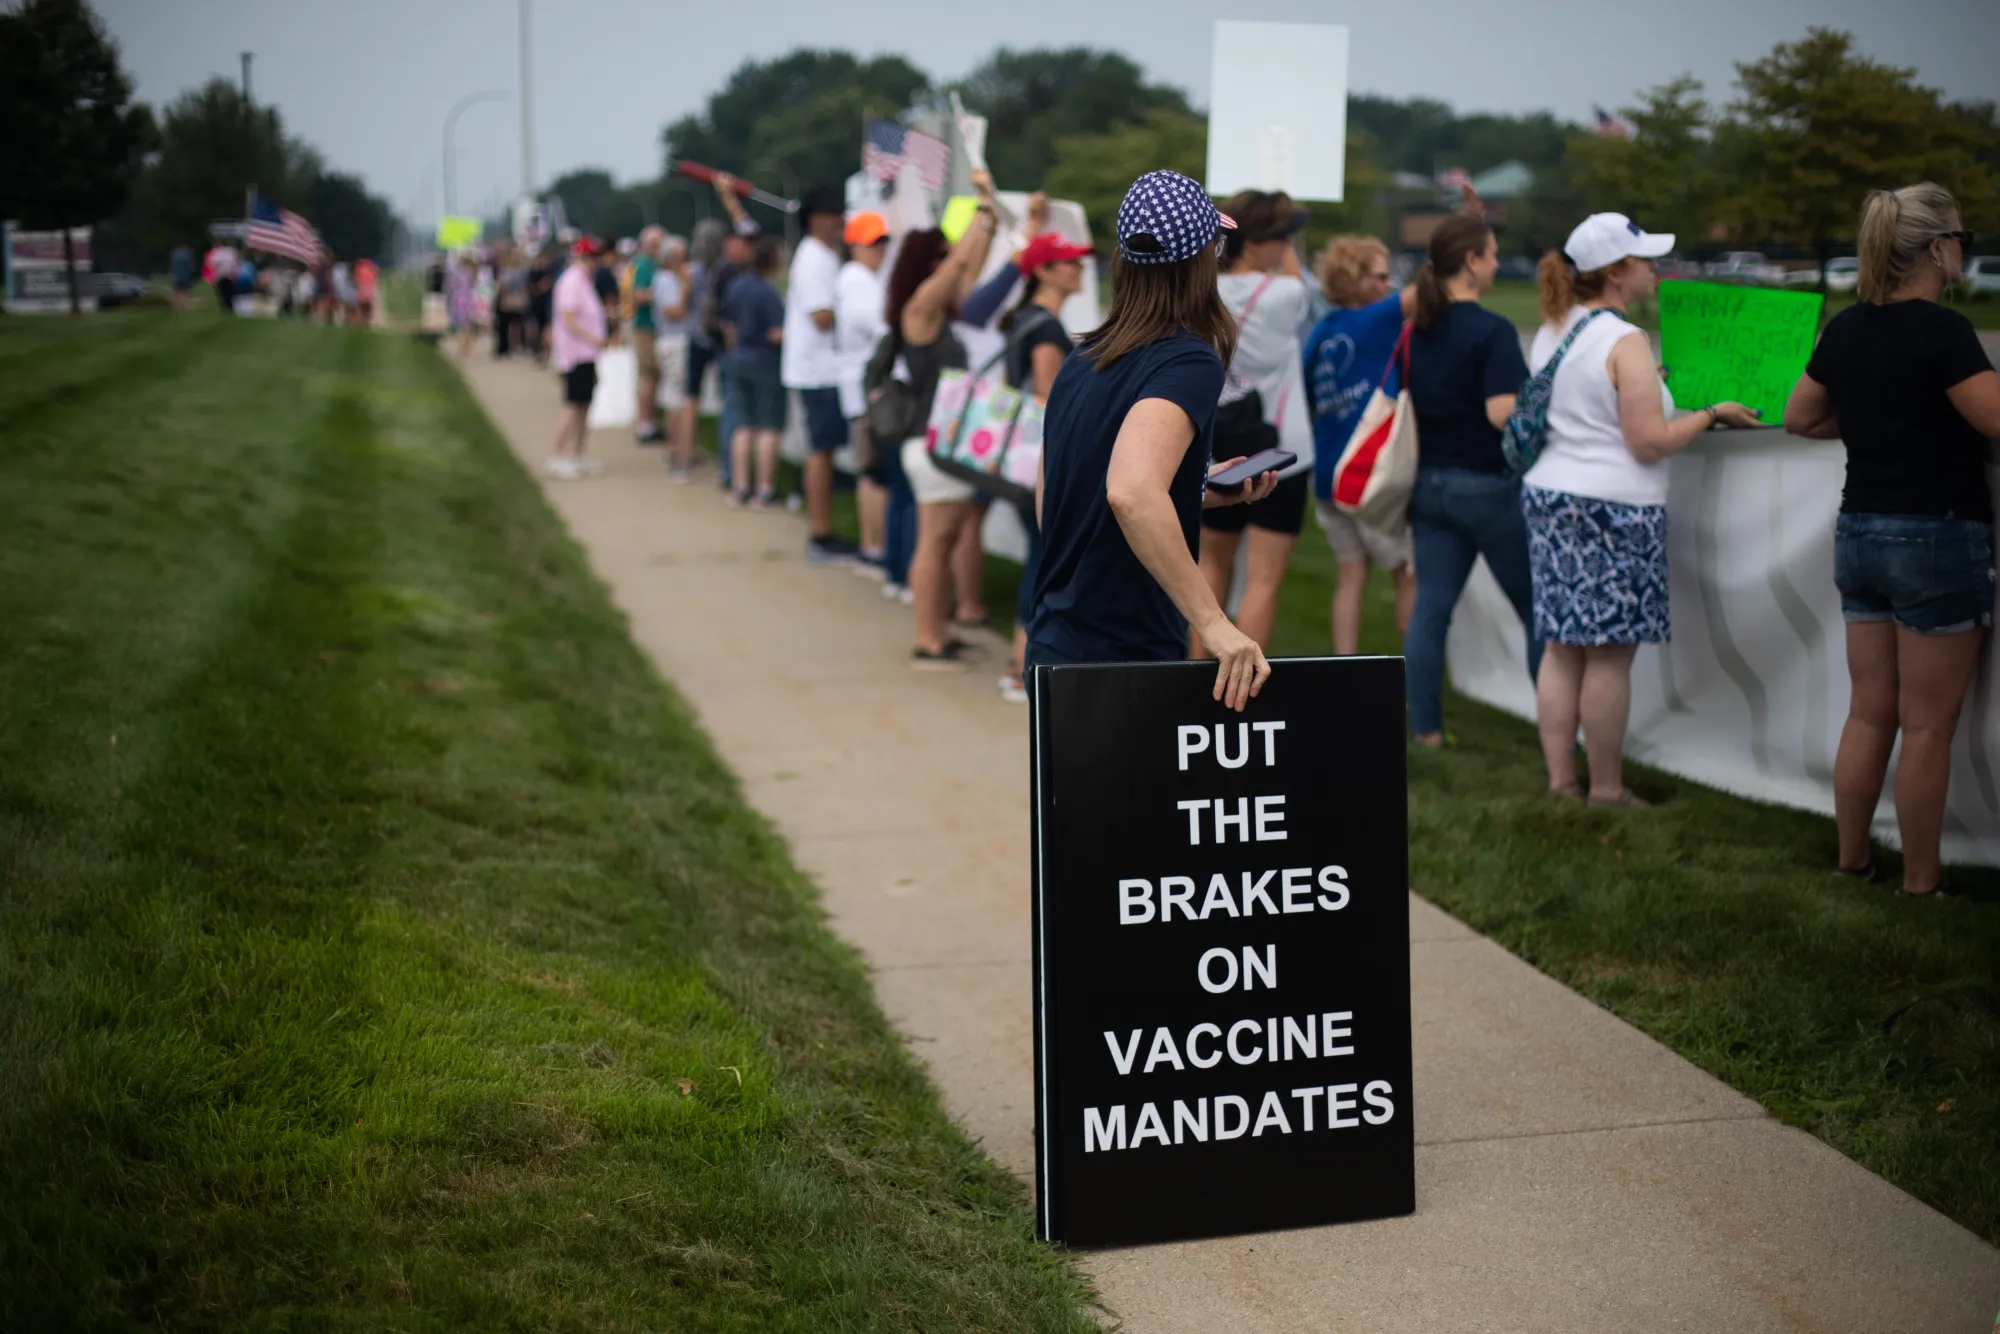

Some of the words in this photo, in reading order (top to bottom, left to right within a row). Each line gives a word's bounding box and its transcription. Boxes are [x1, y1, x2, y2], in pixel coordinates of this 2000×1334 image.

[1177, 720, 1286, 771] PUT
[1176, 794, 1288, 846] THE
[1118, 865, 1350, 925] BRAKES
[1197, 943, 1277, 994] ON
[1103, 1010, 1355, 1075] VACCINE
[1083, 1079, 1395, 1153] MANDATES
